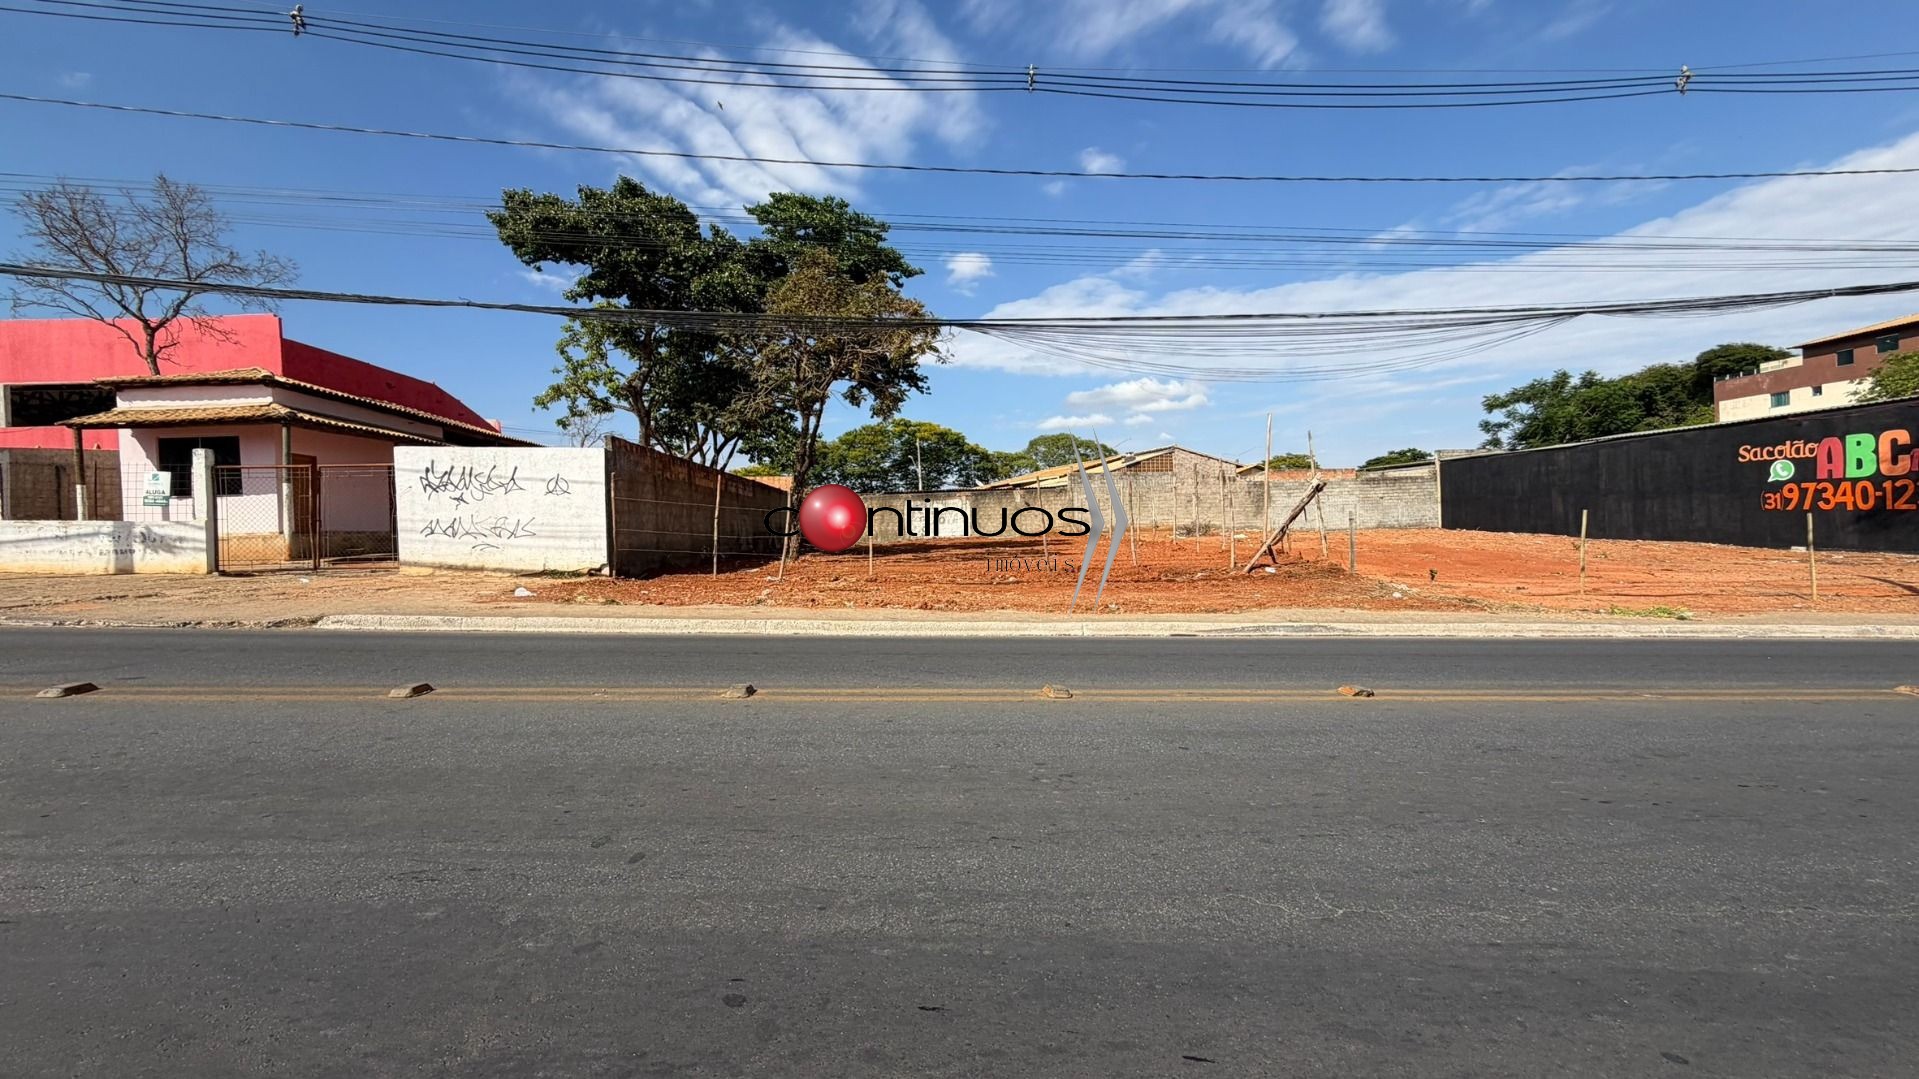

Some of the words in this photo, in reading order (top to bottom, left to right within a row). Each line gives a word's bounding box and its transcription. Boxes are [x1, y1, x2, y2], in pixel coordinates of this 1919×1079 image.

[1738, 440, 1820, 462] Sacolão
[1816, 429, 1911, 479] ABC
[1761, 479, 1919, 511] (31)97340-12
